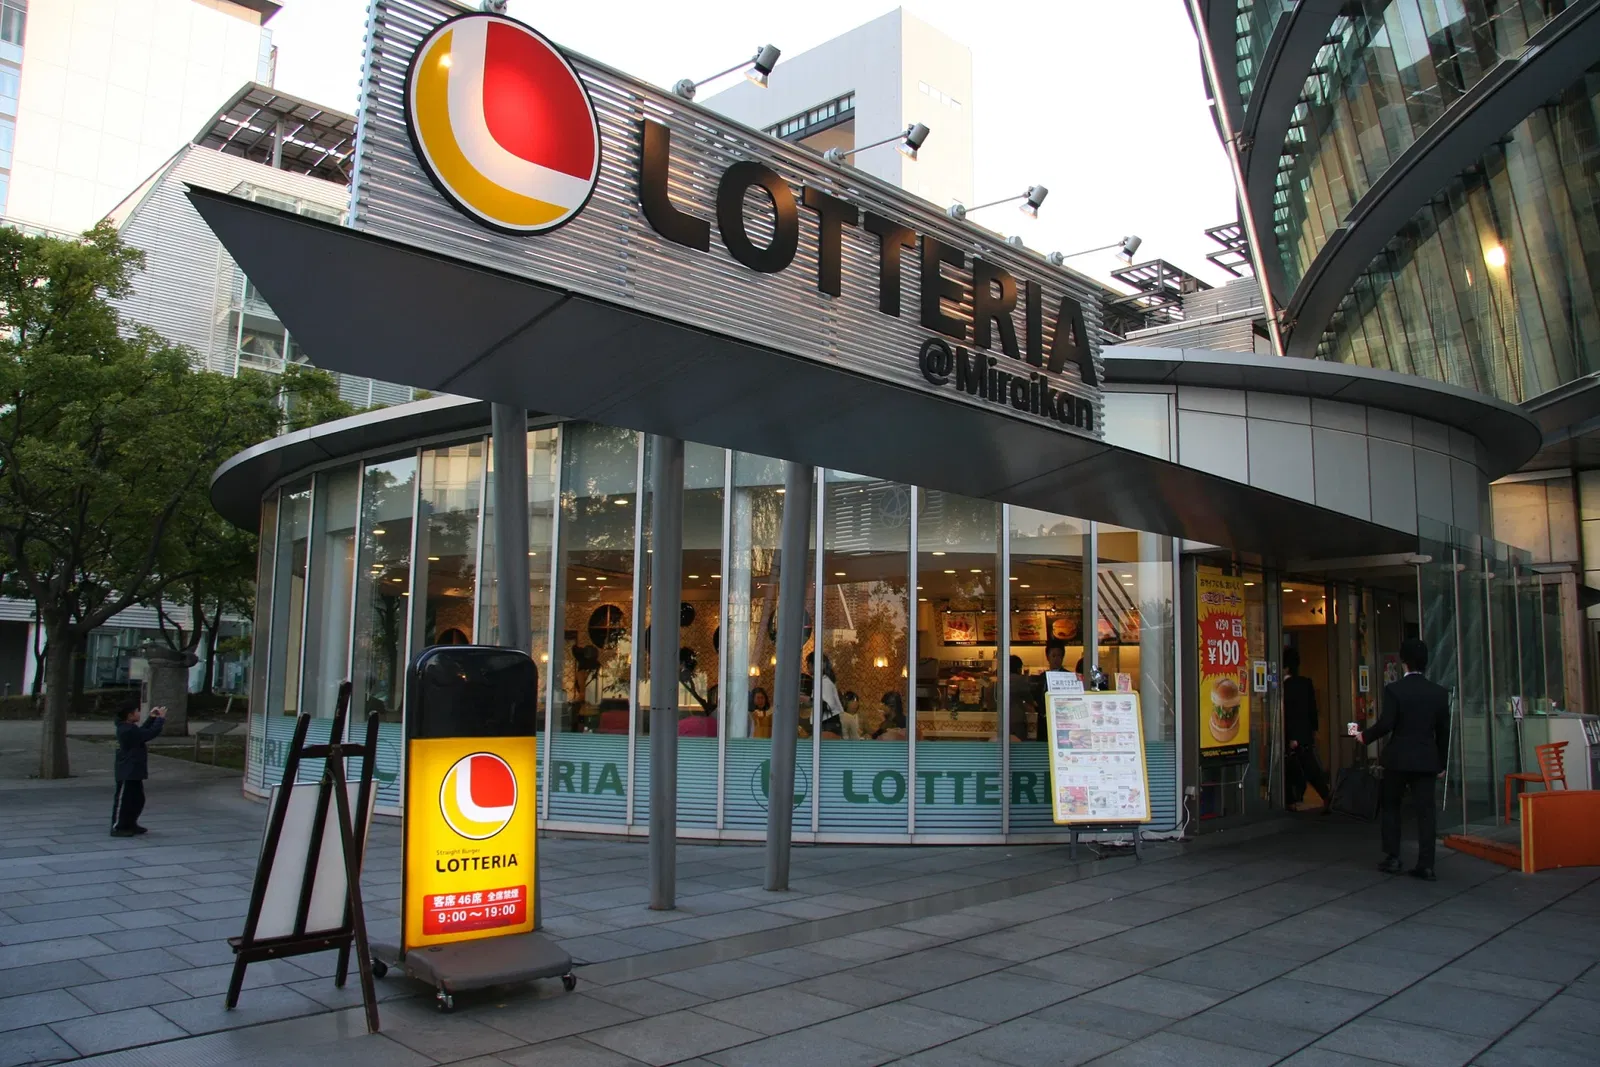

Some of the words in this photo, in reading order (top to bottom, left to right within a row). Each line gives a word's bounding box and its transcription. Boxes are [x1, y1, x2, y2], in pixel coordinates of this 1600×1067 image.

[639, 118, 1098, 386] LOTTERIA
[919, 337, 1094, 432] @Miraikan
[1208, 639, 1240, 666] ¥190
[437, 854, 517, 872] LOTTERIA
